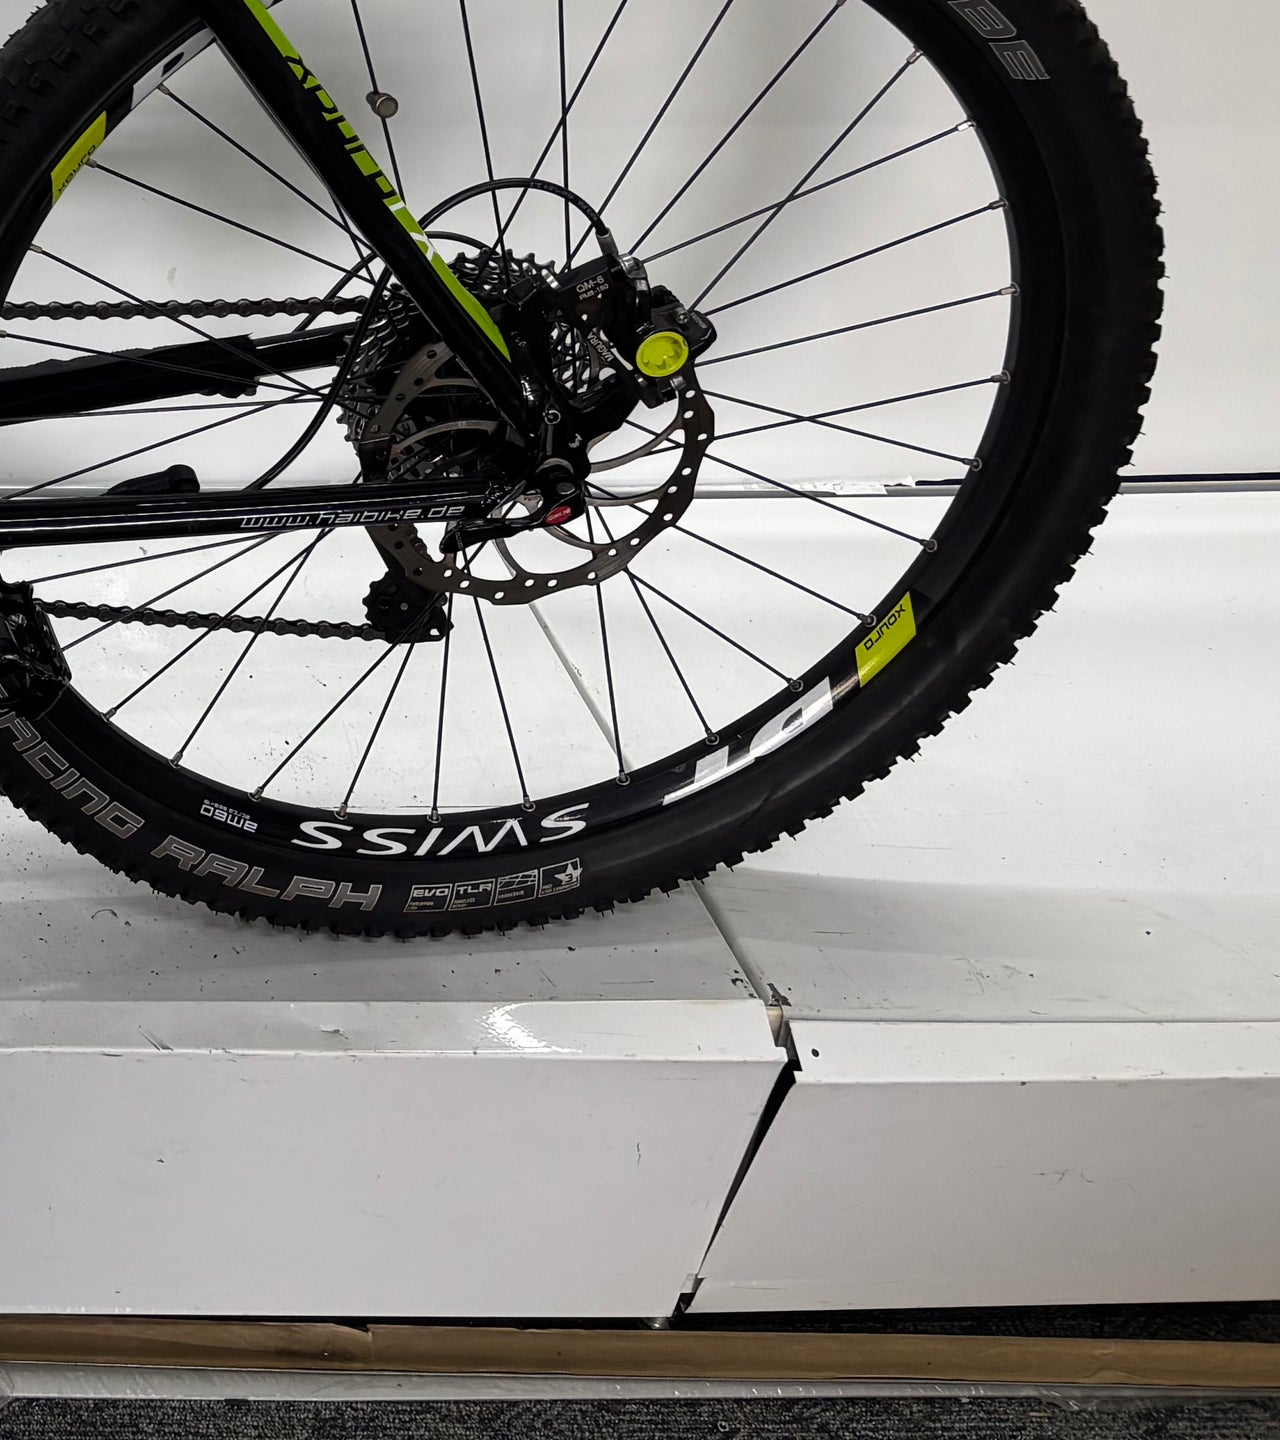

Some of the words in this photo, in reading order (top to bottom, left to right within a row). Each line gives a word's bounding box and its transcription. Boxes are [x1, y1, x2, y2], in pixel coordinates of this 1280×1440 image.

[240, 502, 467, 530] www.haibike.de
[290, 802, 590, 858] SWISS
[149, 834, 383, 912] RALPH
[411, 886, 449, 898] EVO
[456, 881, 493, 896] TLR
